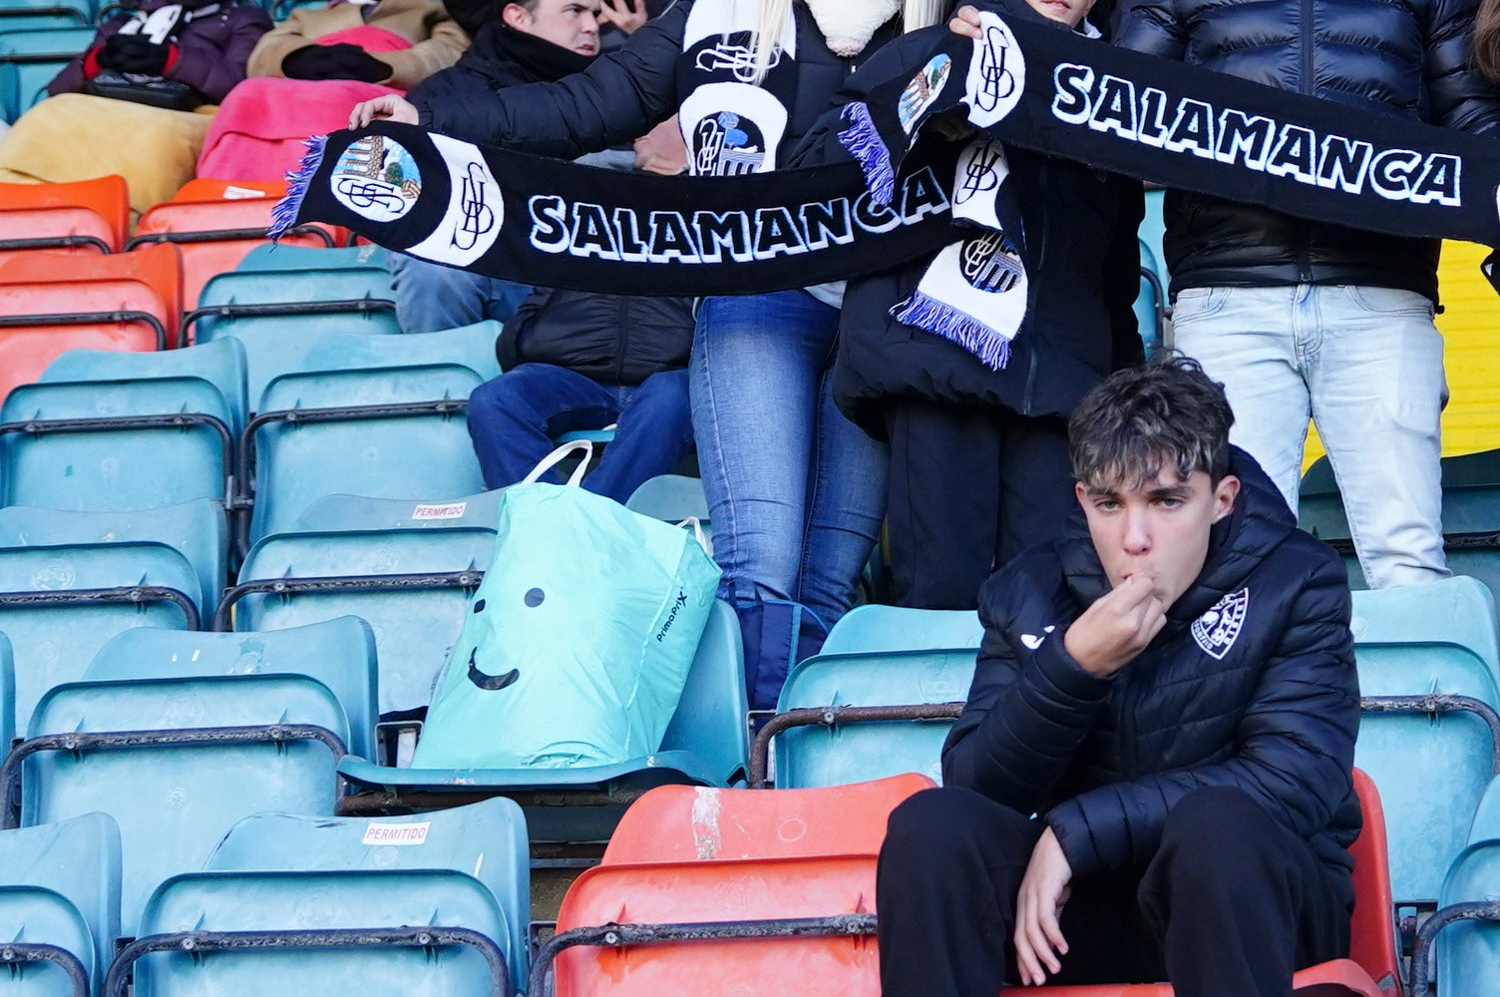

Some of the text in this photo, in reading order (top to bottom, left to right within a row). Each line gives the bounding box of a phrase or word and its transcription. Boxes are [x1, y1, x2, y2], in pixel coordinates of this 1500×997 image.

[1051, 61, 1461, 207] SALAMANCA
[529, 165, 952, 264] SALAMANCA
[414, 505, 464, 517] PERMITIDO
[366, 826, 427, 841] PERMITIDO
